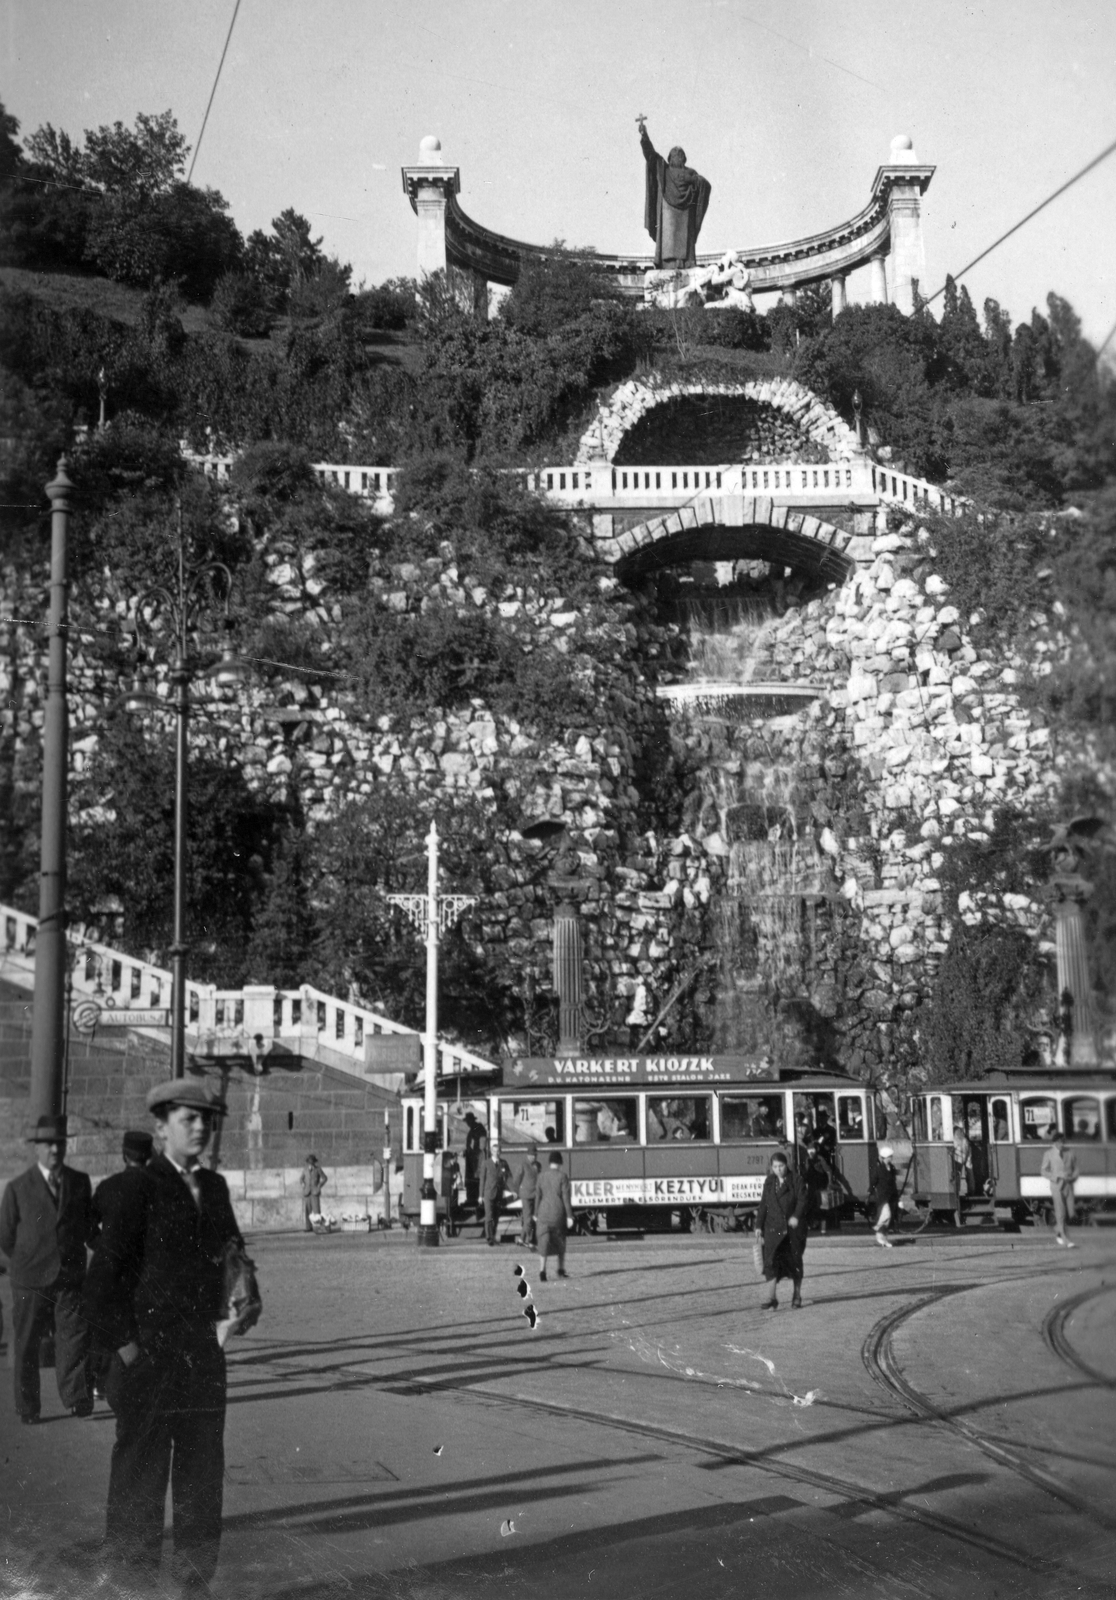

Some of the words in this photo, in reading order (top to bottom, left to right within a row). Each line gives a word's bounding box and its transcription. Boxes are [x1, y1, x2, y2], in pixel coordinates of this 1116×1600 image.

[554, 1058, 639, 1074] VÁRKERT
[646, 1058, 714, 1072] KIOSZK
[565, 1075, 631, 1083] KATONAZENE
[521, 1108, 529, 1121] 71
[1026, 1109, 1035, 1122] 71
[574, 1182, 614, 1197] KLER
[732, 1191, 762, 1199] KECSKEM
